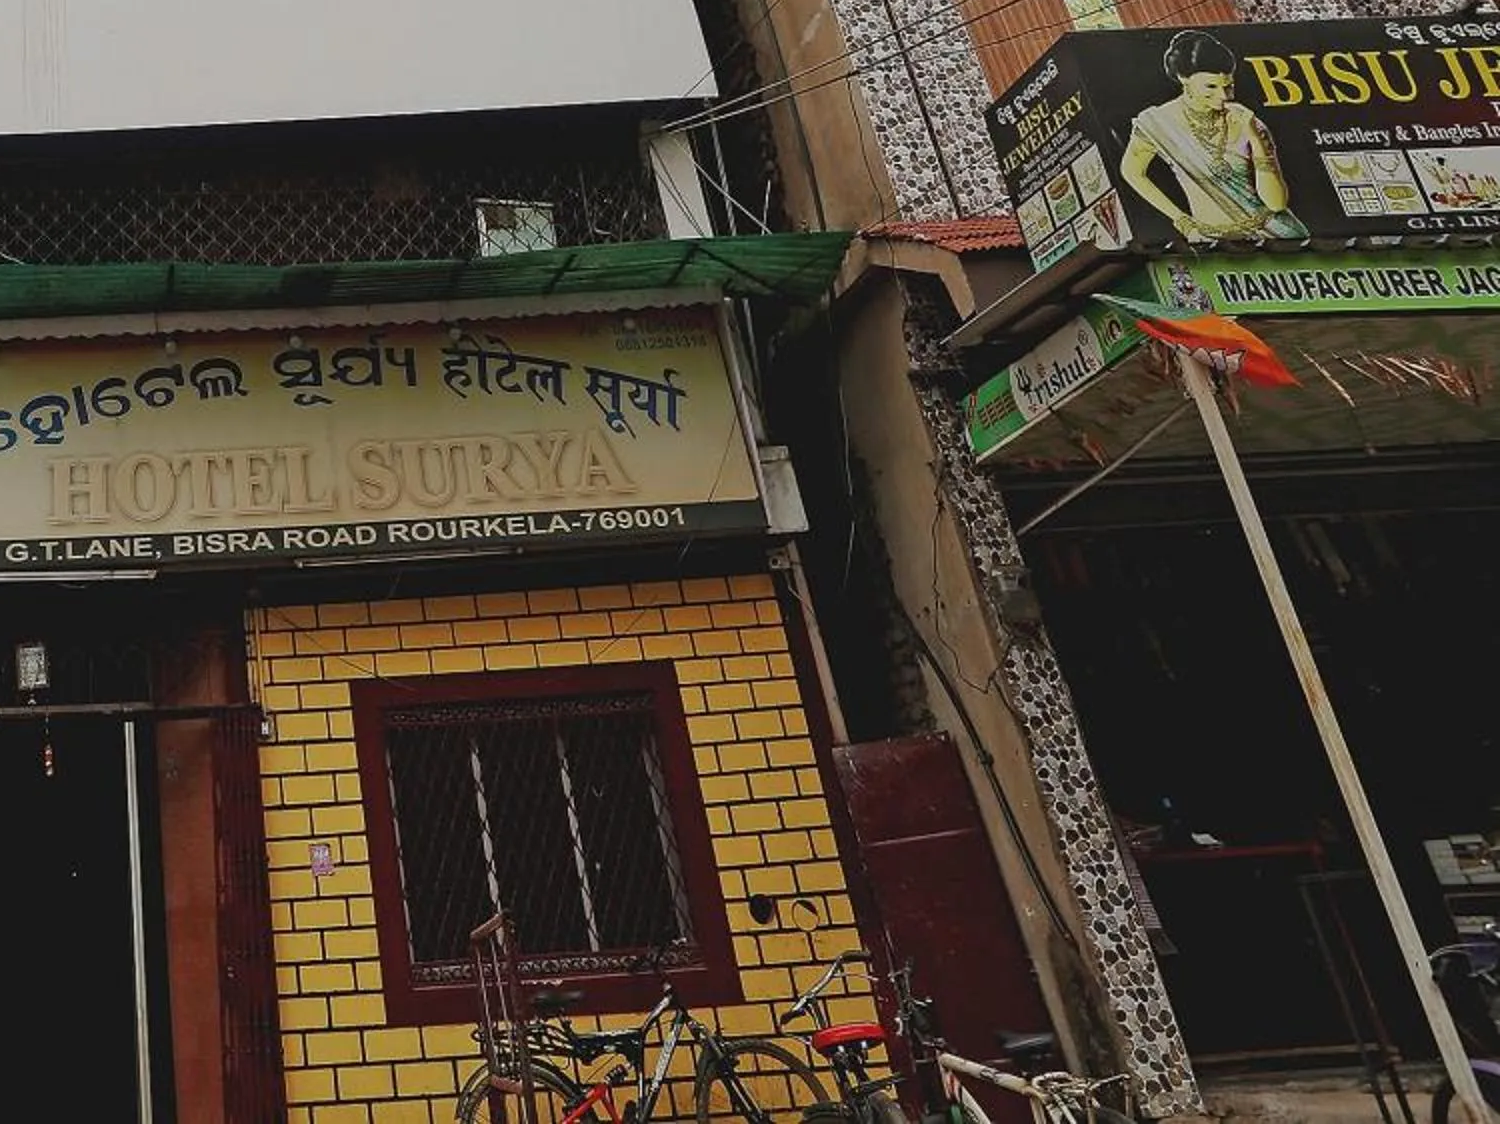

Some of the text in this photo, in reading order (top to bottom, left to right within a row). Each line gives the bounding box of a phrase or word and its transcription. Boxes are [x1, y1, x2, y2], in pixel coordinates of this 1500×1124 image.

[1244, 49, 1417, 107] BISU
[1002, 90, 1084, 176] JEWELLERY
[1016, 98, 1051, 140] BISU
[1312, 128, 1390, 147] Jewellery
[1395, 126, 1412, 142] &
[1414, 125, 1481, 145] Bangles
[1217, 265, 1450, 303] MANUFACTURER
[46, 427, 638, 526] HOTEL SURYA
[5, 507, 686, 563] G.T.LANE, BISRA ROAD ROURKELA-769001
